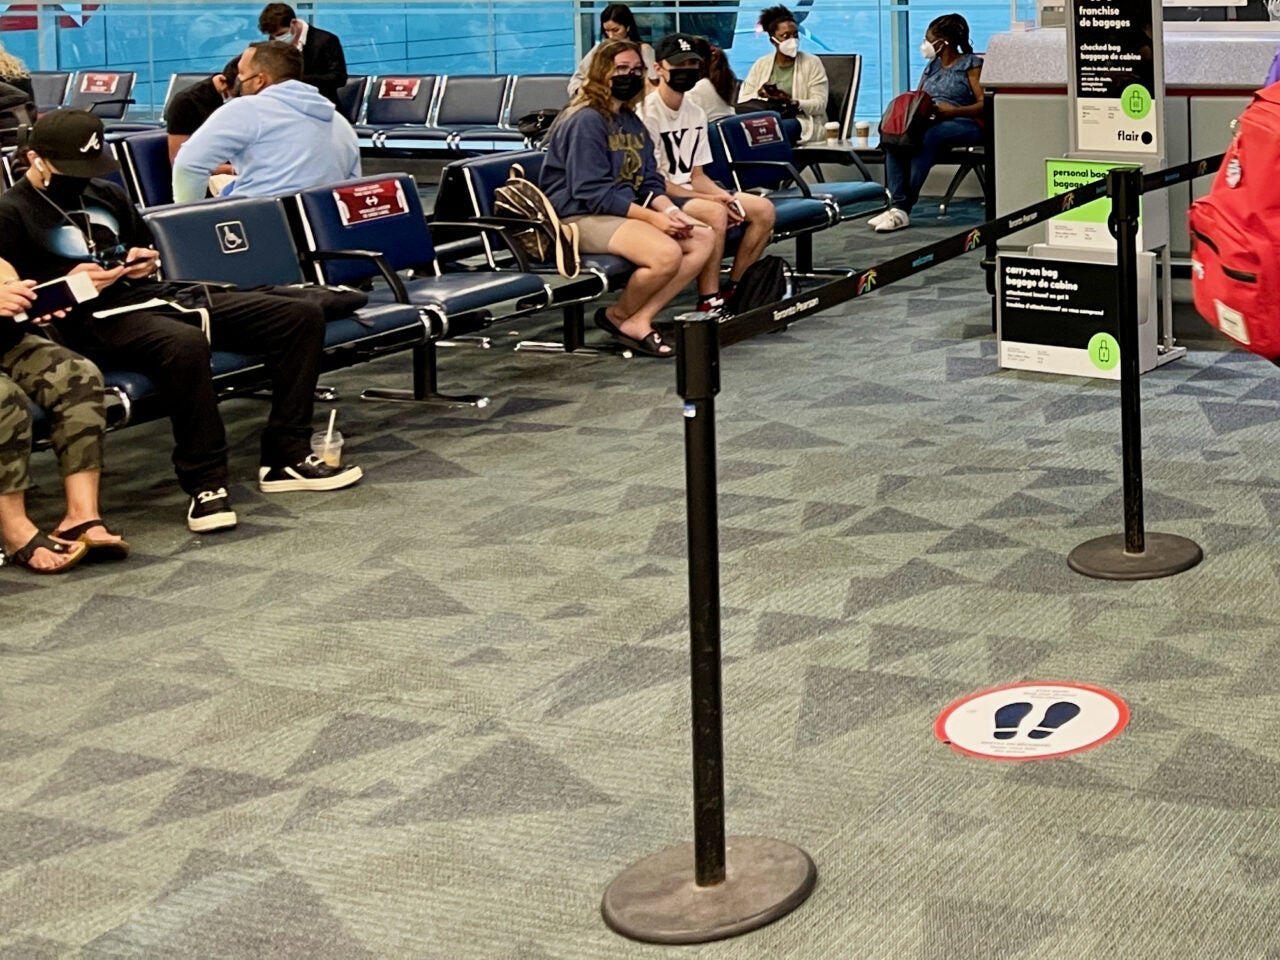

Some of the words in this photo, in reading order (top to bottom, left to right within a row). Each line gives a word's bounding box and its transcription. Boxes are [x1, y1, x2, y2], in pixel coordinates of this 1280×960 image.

[1079, 5, 1120, 16] franchise
[1079, 17, 1091, 27] de
[1092, 17, 1131, 29] bagages
[1080, 43, 1107, 51] checked
[1108, 43, 1121, 53] bag
[1110, 52, 1119, 60] de
[1119, 52, 1141, 61] cabine
[1117, 130, 1140, 141] flair
[80, 132, 100, 152] A
[1053, 169, 1088, 178] personal
[1006, 266, 1041, 277] carry-on
[1041, 267, 1058, 280] bag
[1006, 275, 1037, 289] bagage
[1038, 278, 1049, 288] de
[1049, 280, 1078, 291] cabine
[772, 306, 797, 321] Toronto
[796, 297, 819, 312] Pearson
